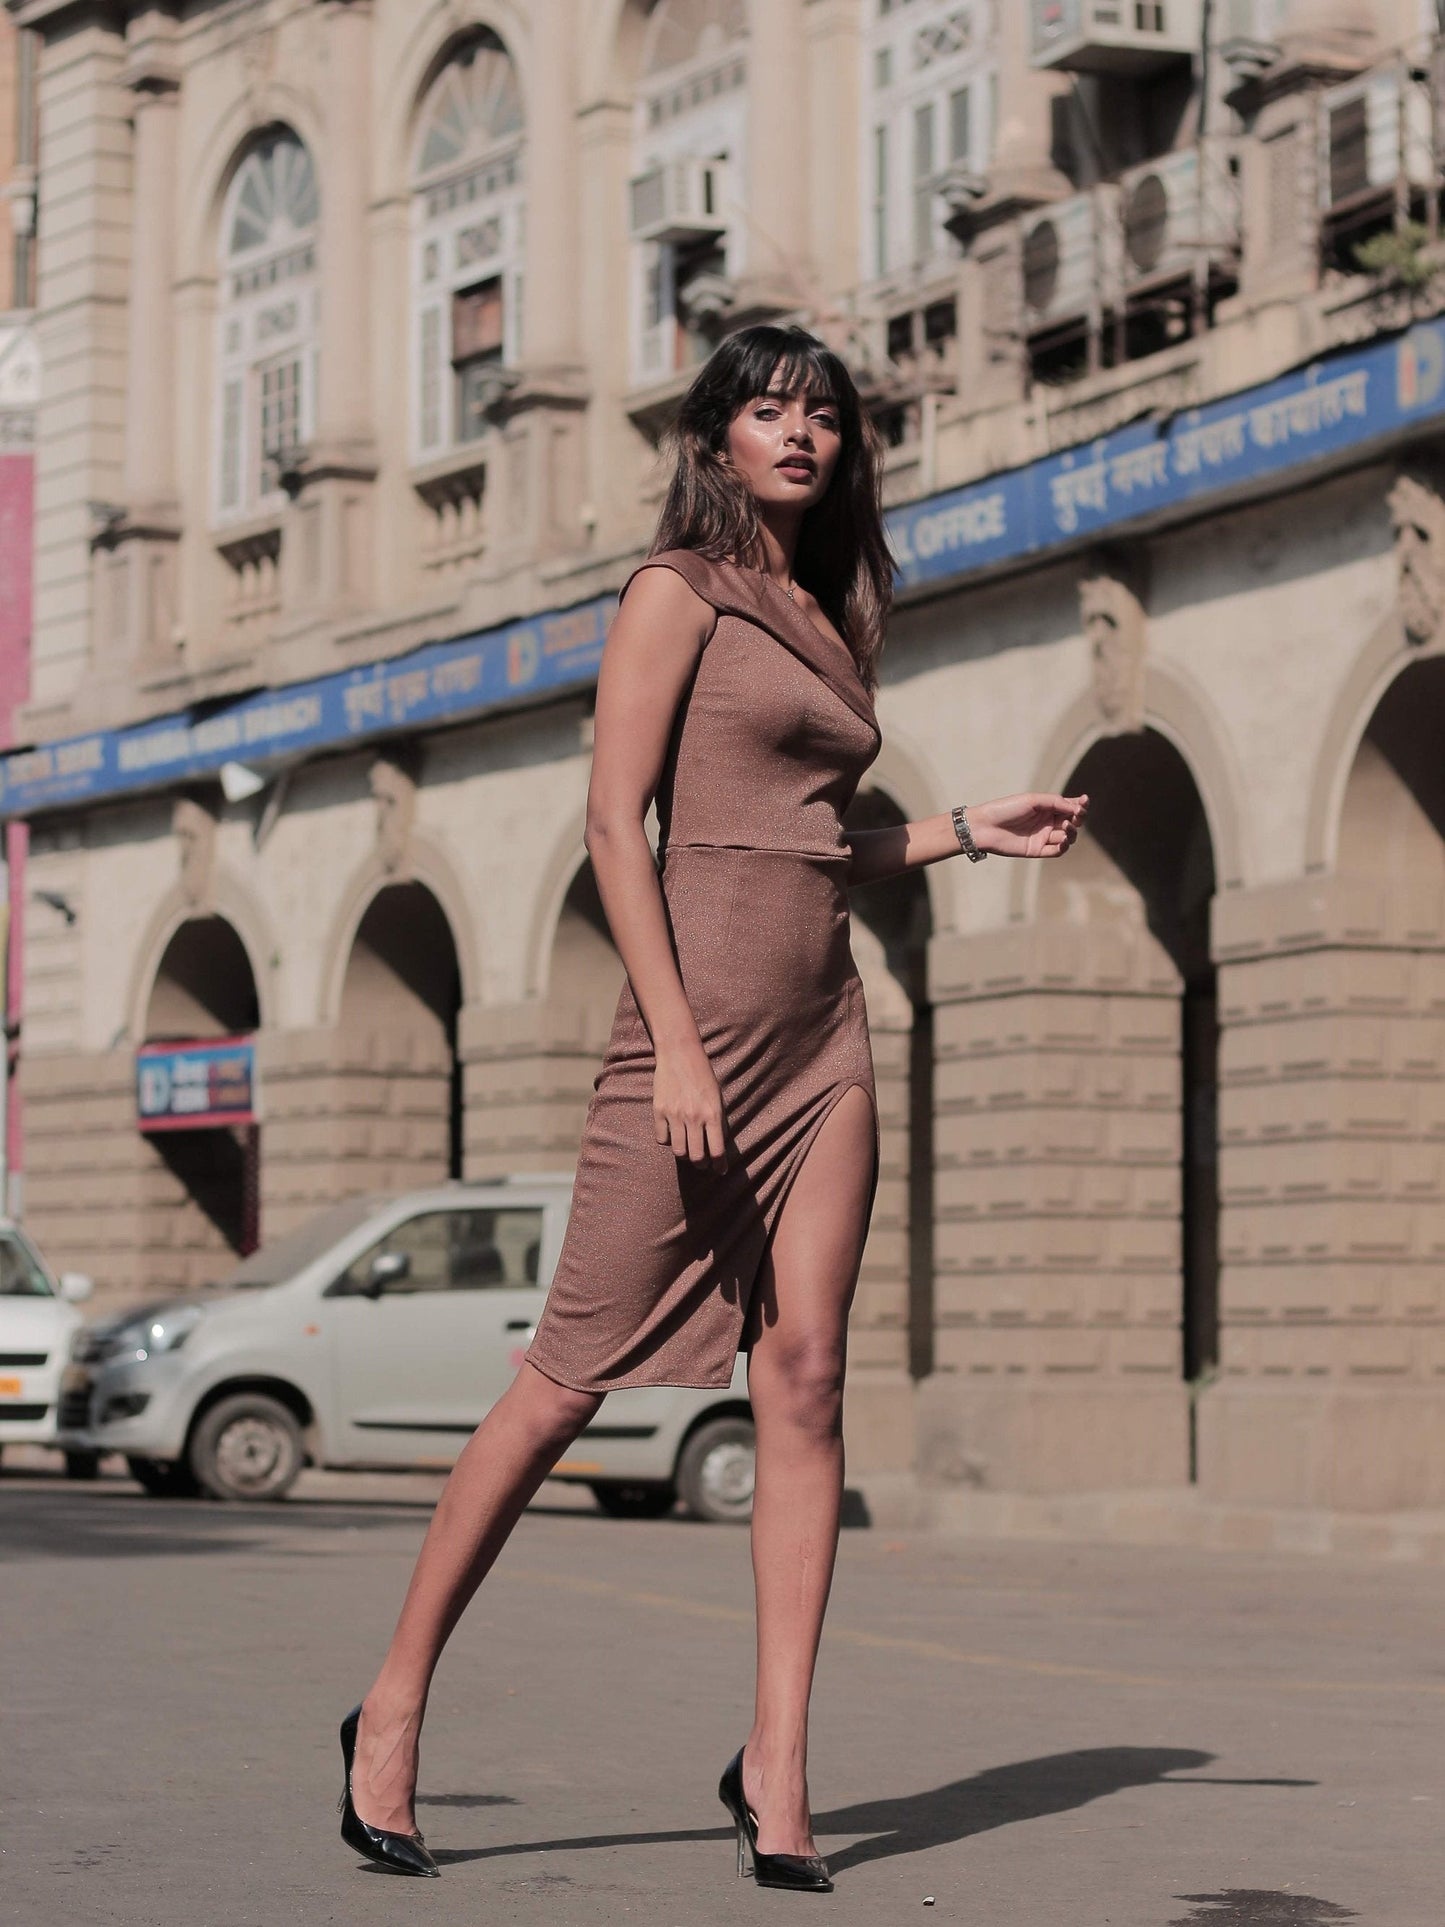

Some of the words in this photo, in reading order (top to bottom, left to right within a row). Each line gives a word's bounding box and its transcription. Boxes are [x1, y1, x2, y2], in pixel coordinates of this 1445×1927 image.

[1052, 439, 1107, 533] मुंबई
[1109, 440, 1169, 494] नगर
[914, 494, 1007, 560] OFFICE
